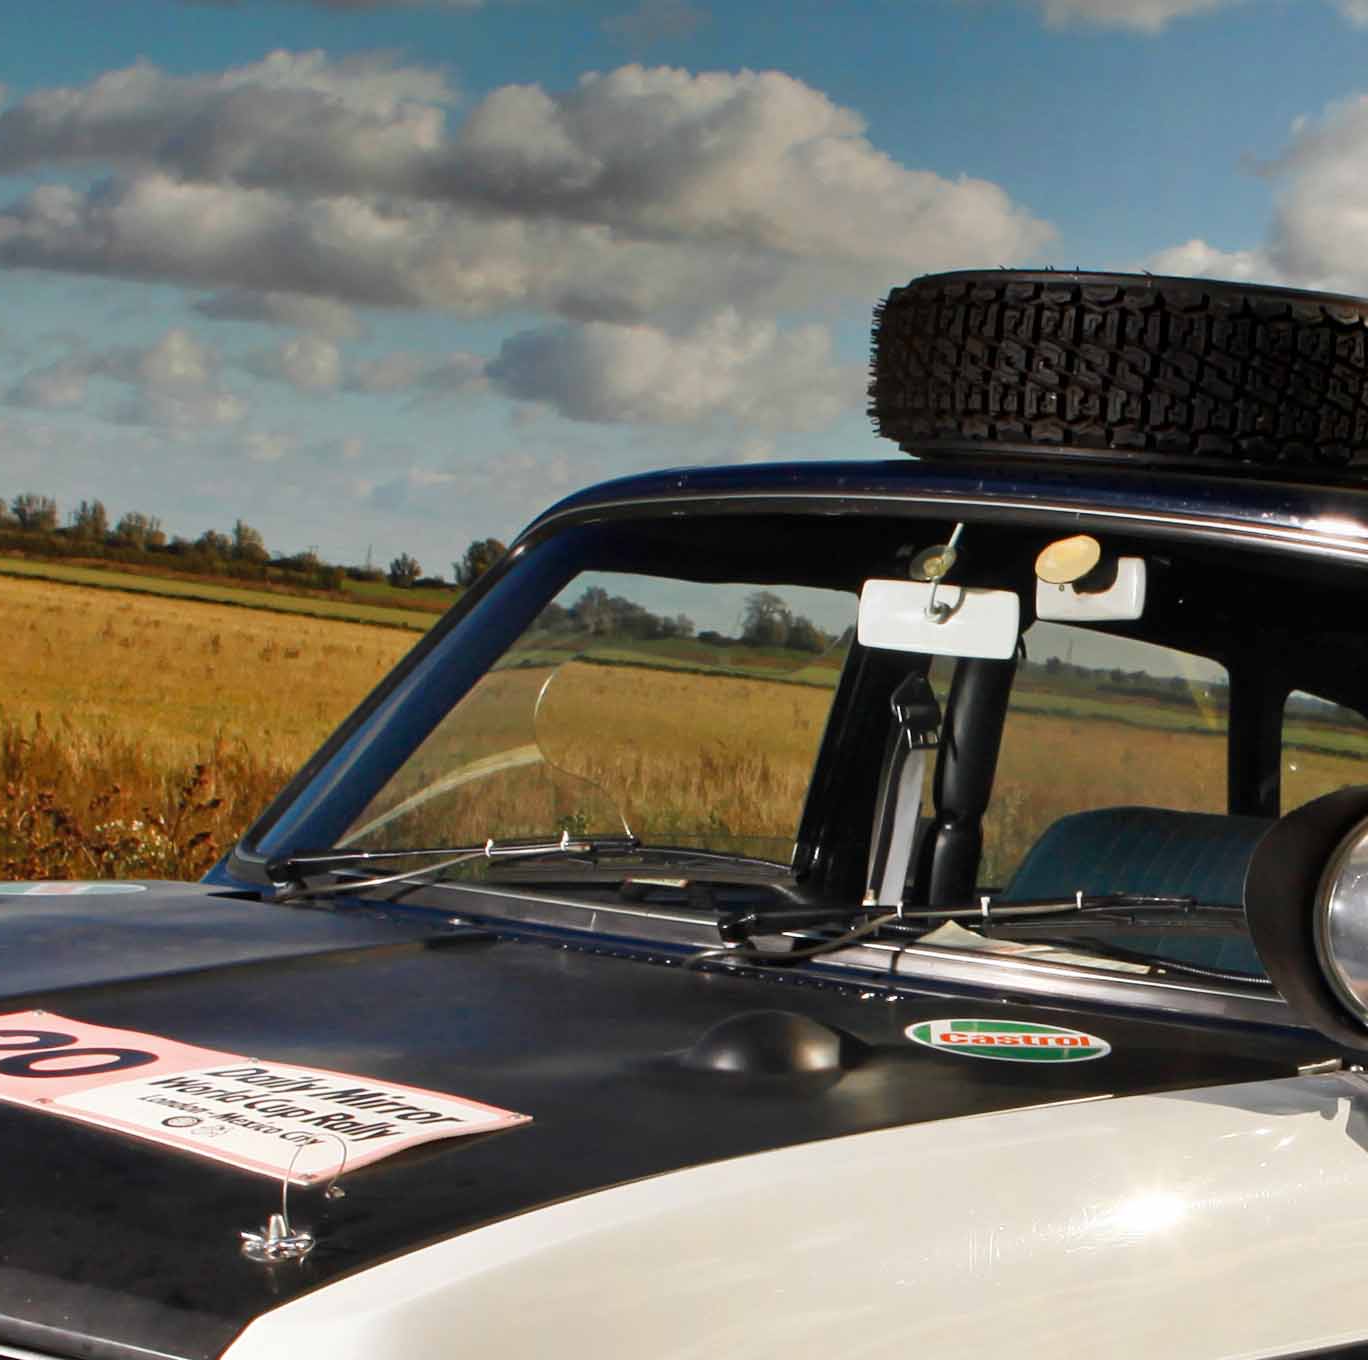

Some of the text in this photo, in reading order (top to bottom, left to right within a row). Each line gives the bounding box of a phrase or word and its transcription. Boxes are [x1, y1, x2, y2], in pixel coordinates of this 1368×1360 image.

[939, 1031, 1091, 1048] Castrol
[148, 1076, 404, 1143] World Cup Rally
[203, 1067, 465, 1125] Daily Mirror
[210, 1112, 284, 1135] Mexico
[278, 1130, 327, 1146] City
